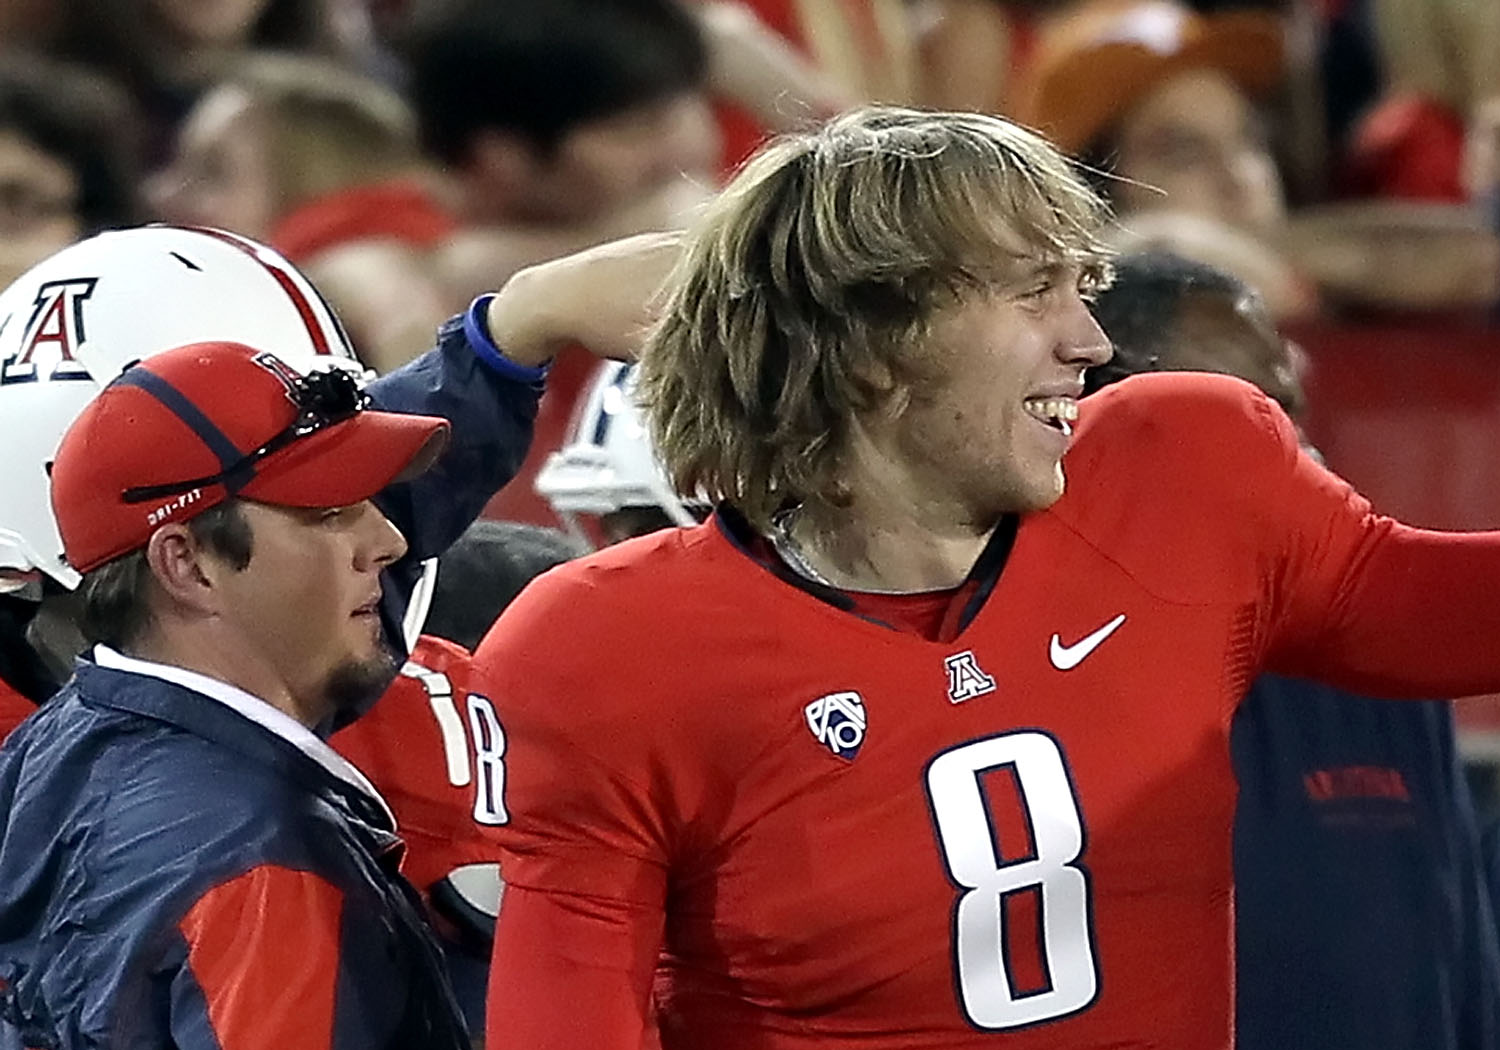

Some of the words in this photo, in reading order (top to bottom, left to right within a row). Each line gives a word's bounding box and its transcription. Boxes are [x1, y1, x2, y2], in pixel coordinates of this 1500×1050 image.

[1, 277, 99, 386] A
[146, 488, 202, 526] DRI-FIT
[805, 691, 867, 742] PAC
[945, 651, 997, 704] A
[466, 692, 510, 826] 8
[922, 728, 1101, 1033] 8
